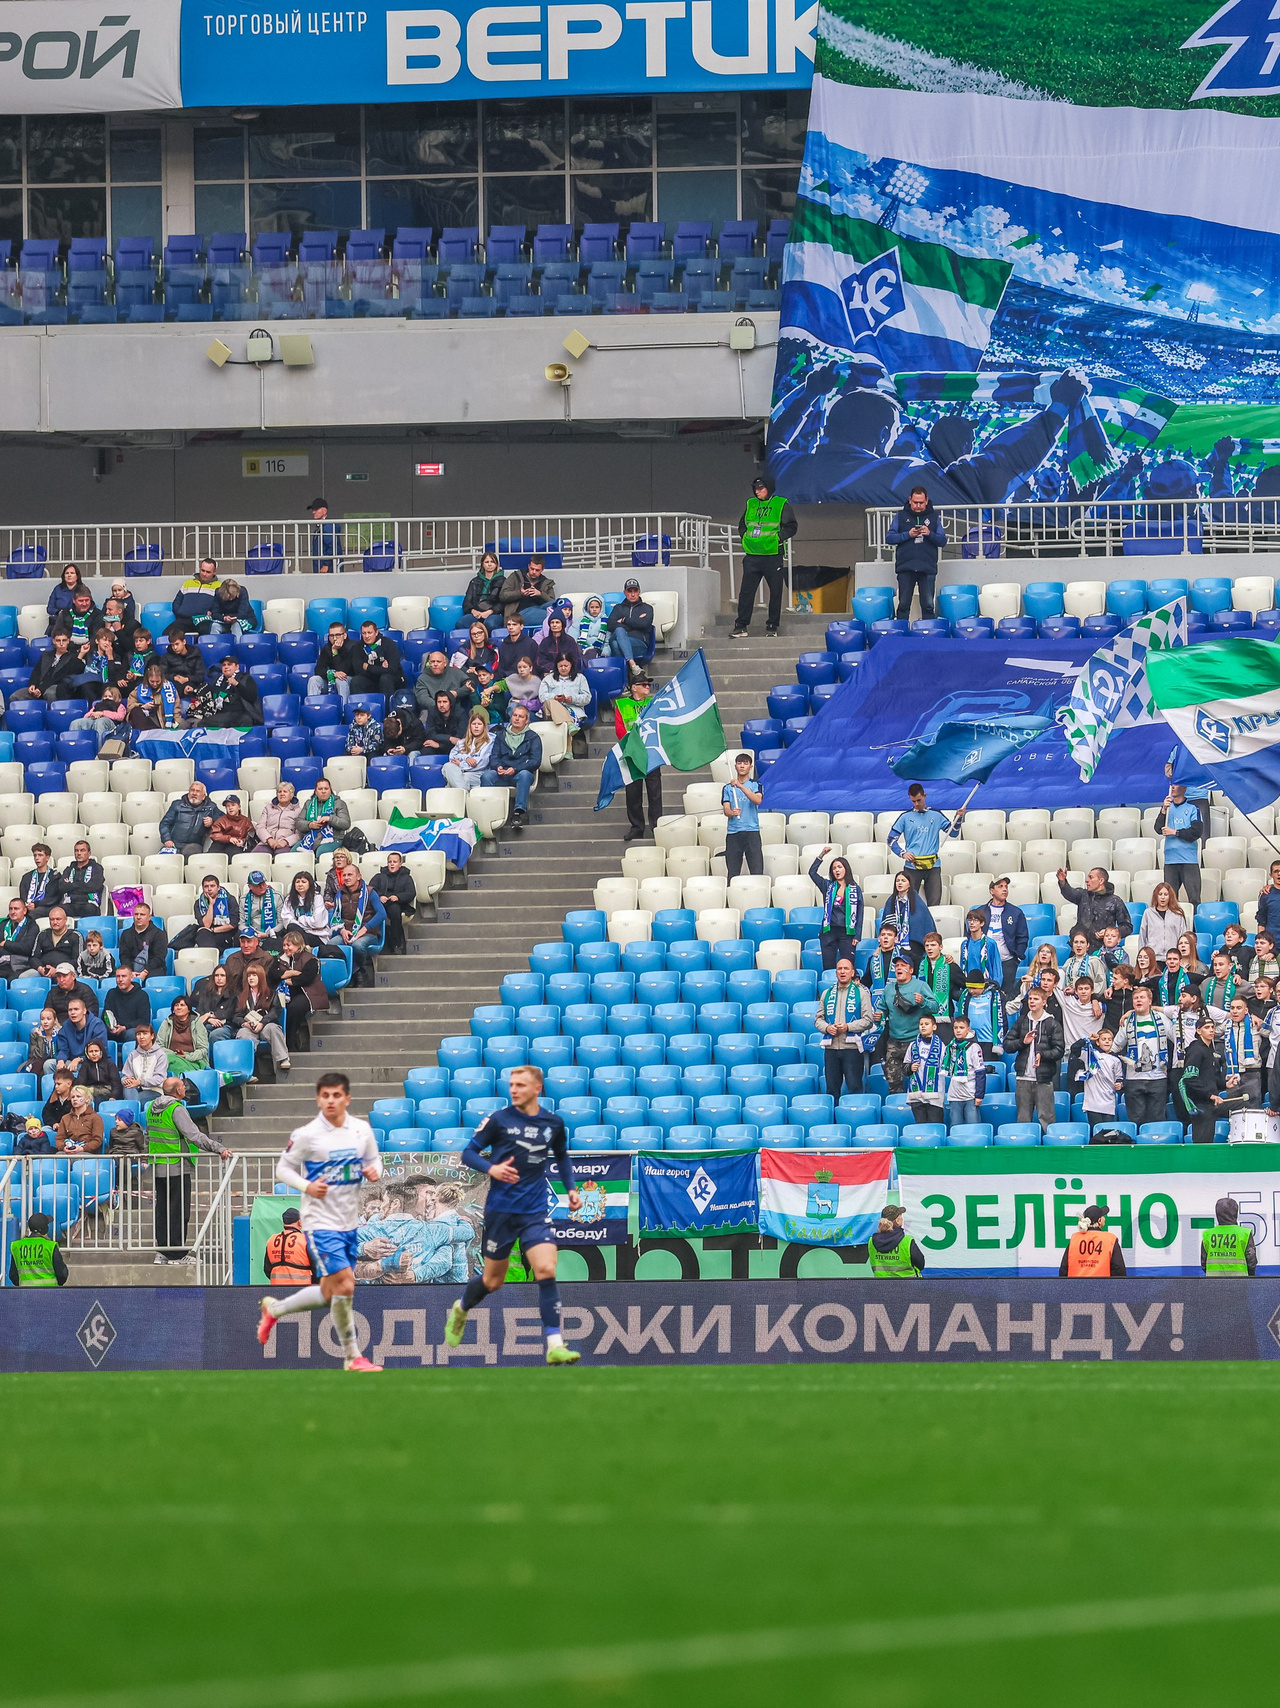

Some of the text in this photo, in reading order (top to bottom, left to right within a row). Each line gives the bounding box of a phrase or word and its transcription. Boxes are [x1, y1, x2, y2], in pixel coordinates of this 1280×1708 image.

[203, 9, 368, 36] ТОРГОВЫЙ ЦЕНТР
[265, 459, 286, 473] 116
[442, 912, 451, 920] 12
[412, 944, 420, 952] 11
[409, 1152, 419, 1164] К
[408, 1165, 423, 1175] TO
[549, 1163, 610, 1175] Смару
[644, 1165, 690, 1179] Наш город
[709, 1202, 728, 1212] Наша
[784, 1219, 854, 1244] Самара
[273, 1234, 297, 1248] 63
[1079, 1239, 1103, 1256] 004
[1210, 1233, 1237, 1249] 9742
[19, 1243, 44, 1259] 10112
[757, 1302, 1185, 1362] КОМАНДУ!
